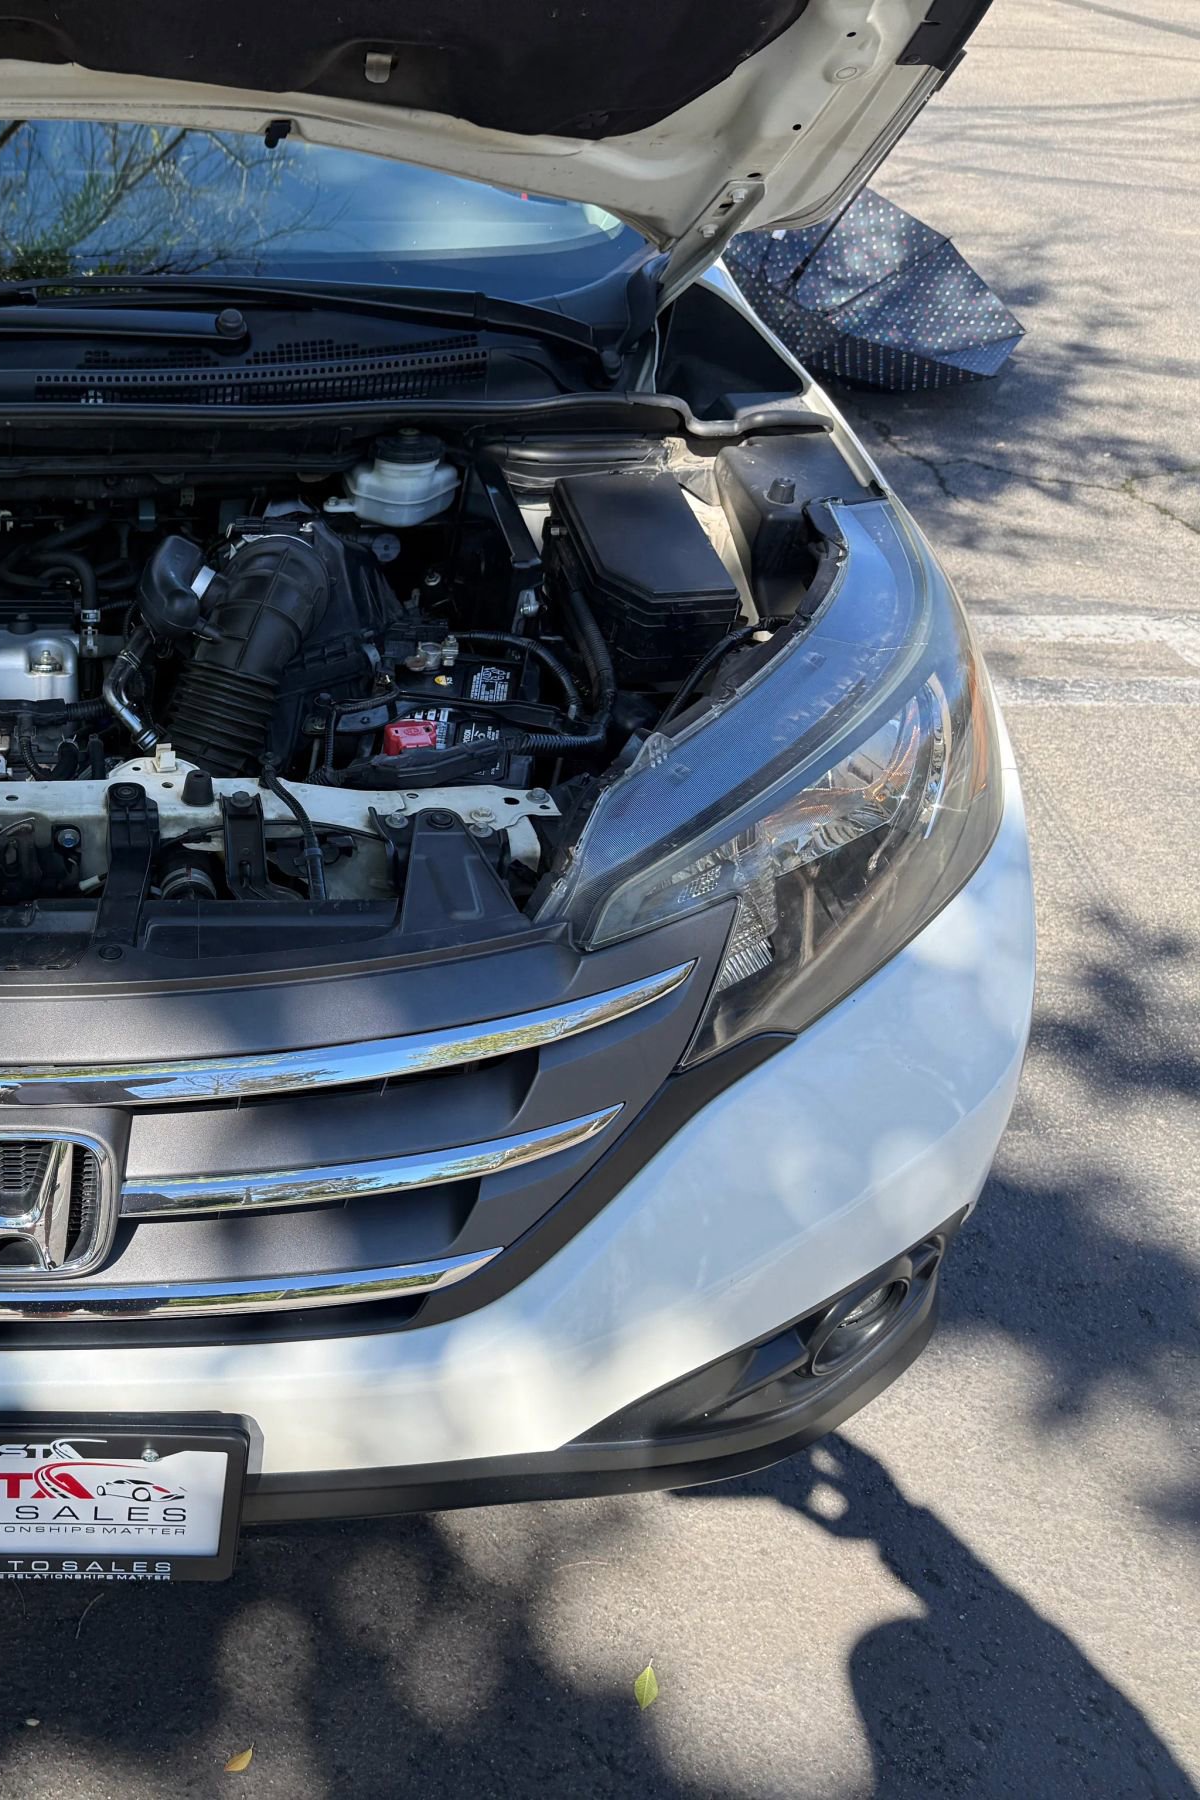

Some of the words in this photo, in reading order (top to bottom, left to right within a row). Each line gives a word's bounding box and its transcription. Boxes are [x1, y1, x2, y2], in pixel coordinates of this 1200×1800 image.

[15, 1505, 187, 1522] SALES
[102, 1526, 185, 1536] MATTER
[61, 1560, 172, 1572] SALES
